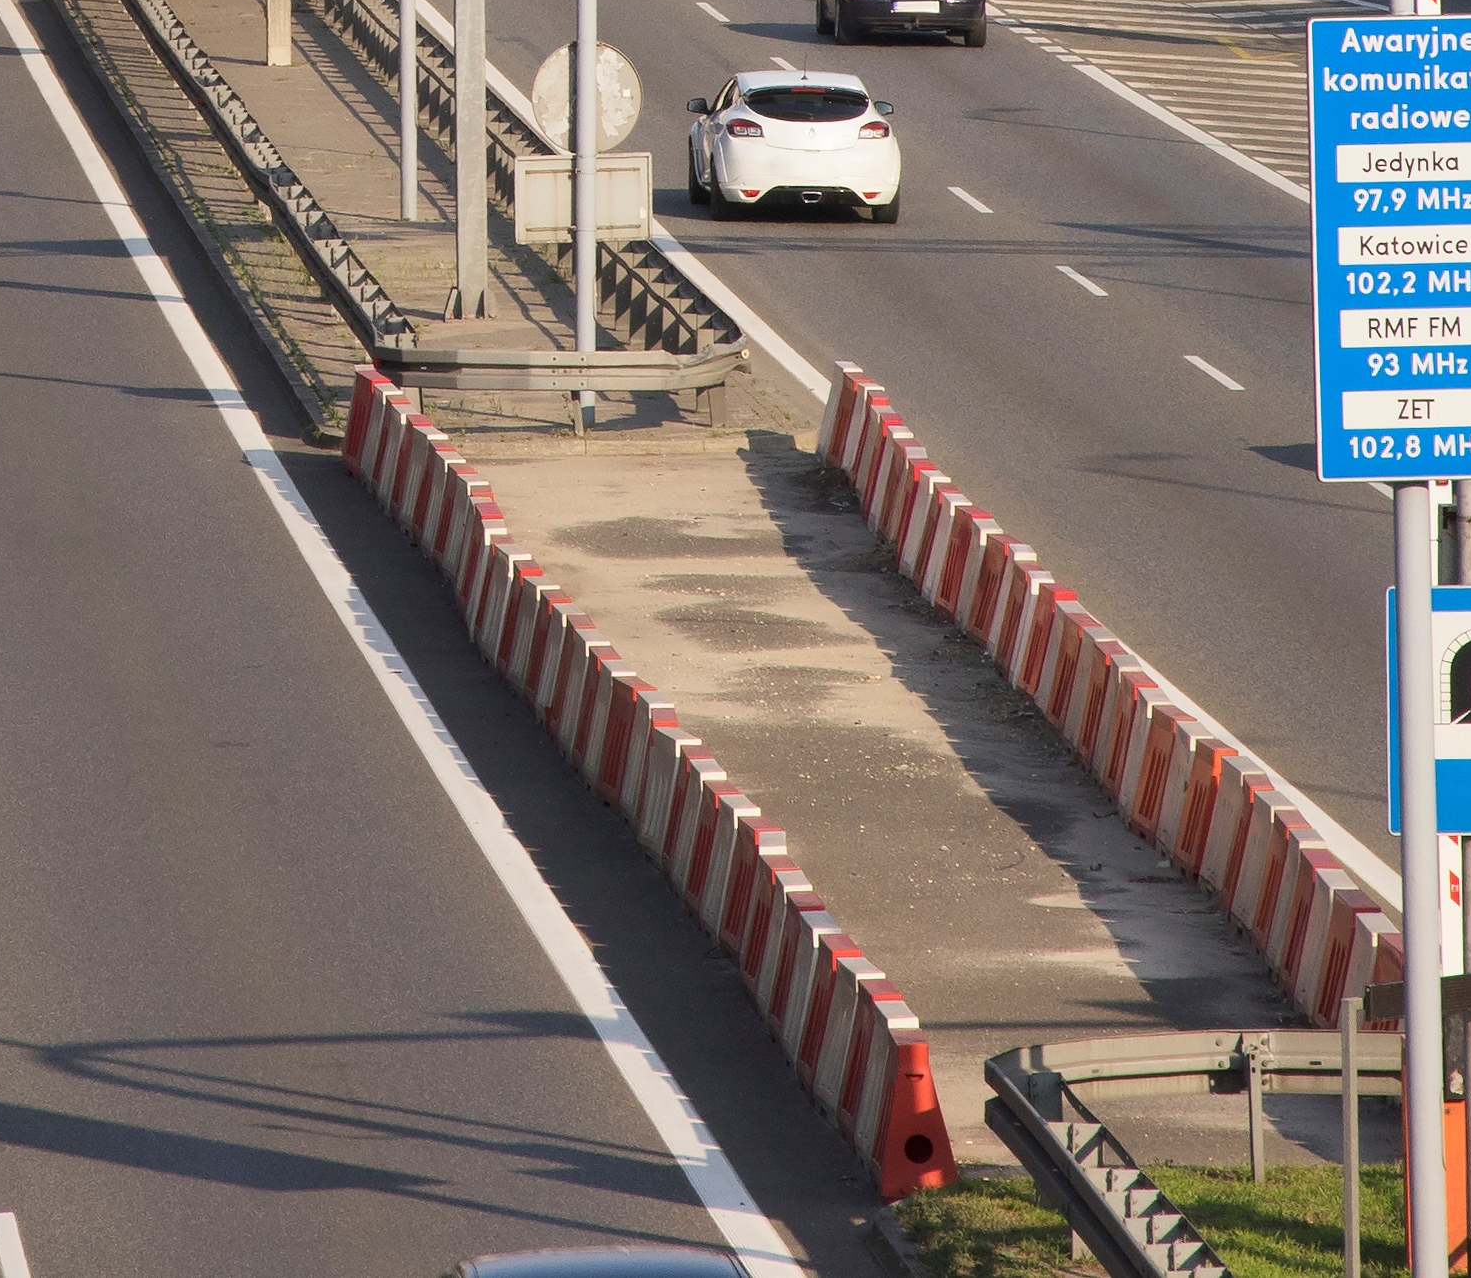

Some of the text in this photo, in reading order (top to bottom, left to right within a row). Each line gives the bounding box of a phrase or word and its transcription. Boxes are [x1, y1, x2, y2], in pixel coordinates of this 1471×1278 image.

[1350, 103, 1471, 130] radiowe
[1362, 150, 1460, 179] Jedynka
[1353, 187, 1407, 214] 97,9
[1359, 233, 1469, 256] Katowice
[1345, 270, 1417, 297] 102,2
[1367, 316, 1462, 339] RMF FM
[1367, 352, 1469, 377] 93 MHz
[1397, 398, 1435, 420] ZET
[1349, 434, 1422, 461] 102,8
